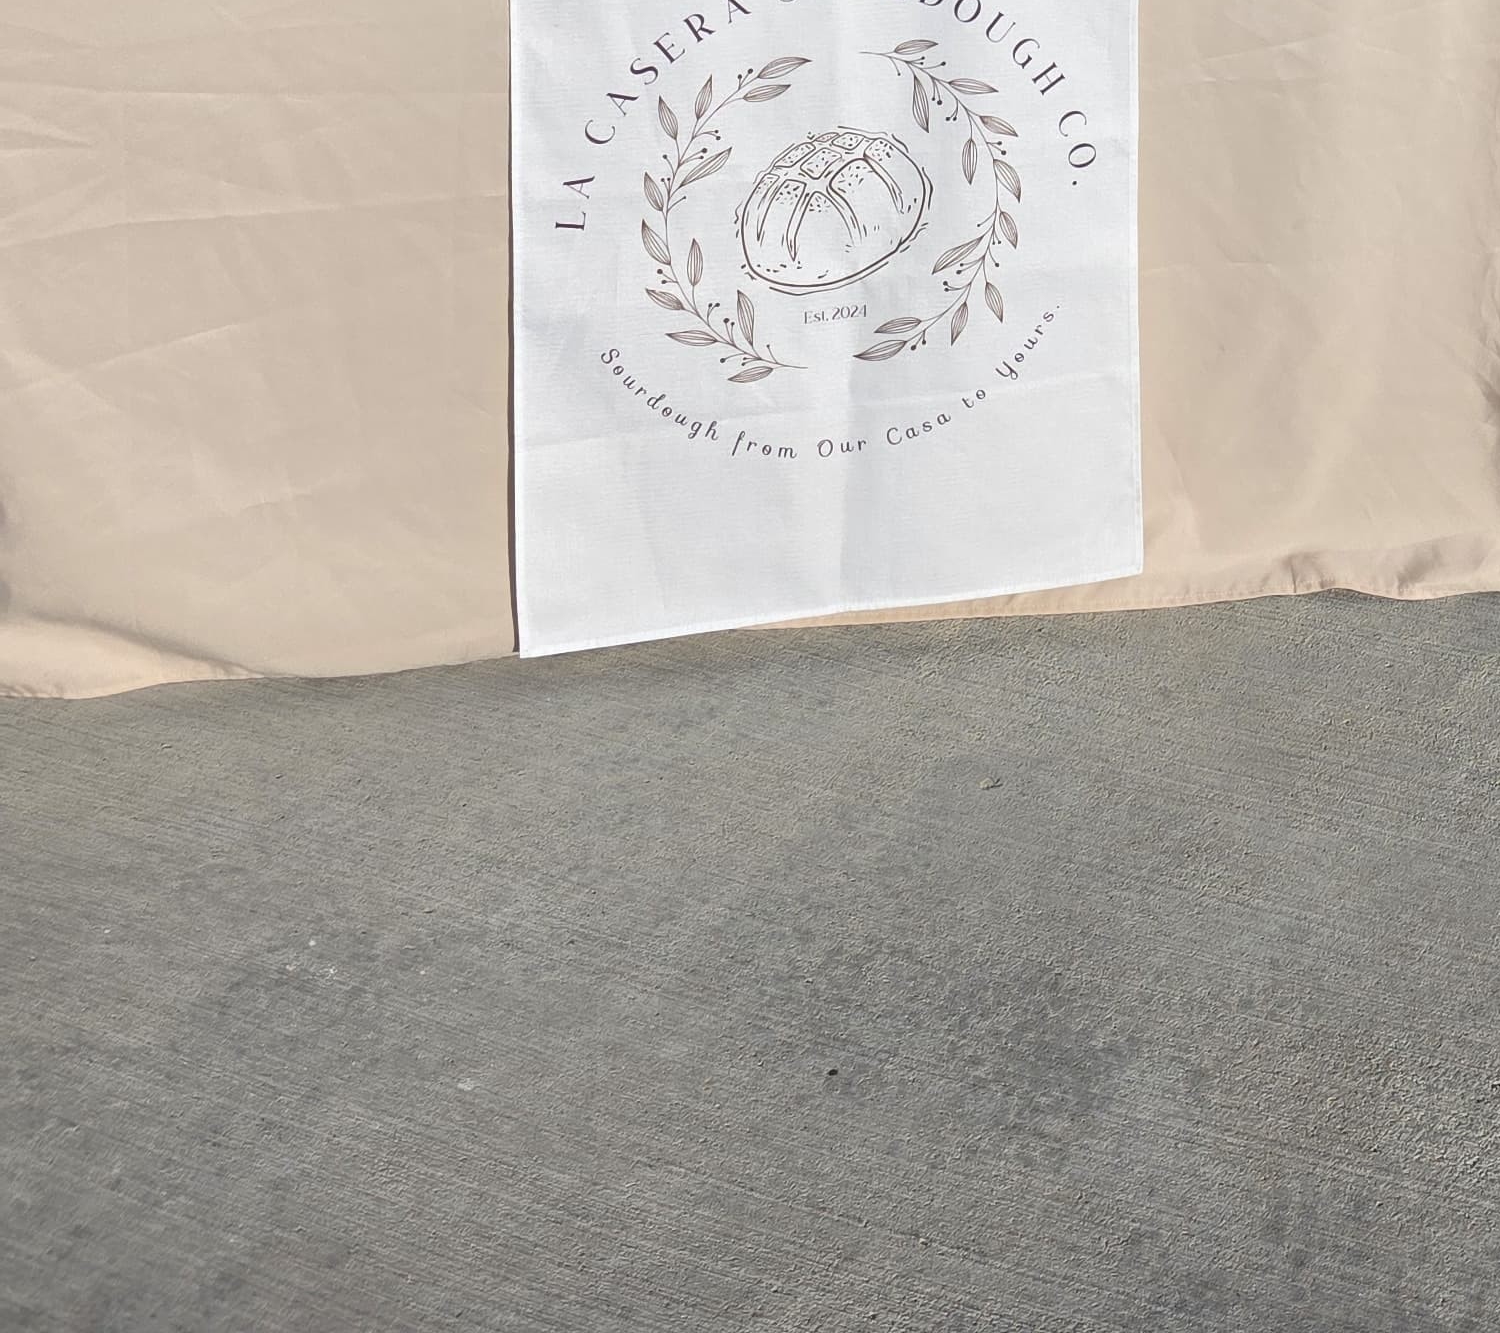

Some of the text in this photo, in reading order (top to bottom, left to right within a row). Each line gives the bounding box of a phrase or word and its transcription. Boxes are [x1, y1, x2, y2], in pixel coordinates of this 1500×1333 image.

[554, 175, 596, 232] LA
[1057, 109, 1098, 187] CO.
[831, 303, 868, 319] 2024
[600, 347, 720, 441] Sourdough
[731, 430, 798, 460] from
[816, 438, 868, 459] Our
[886, 412, 952, 446] Casa
[961, 388, 987, 409] to
